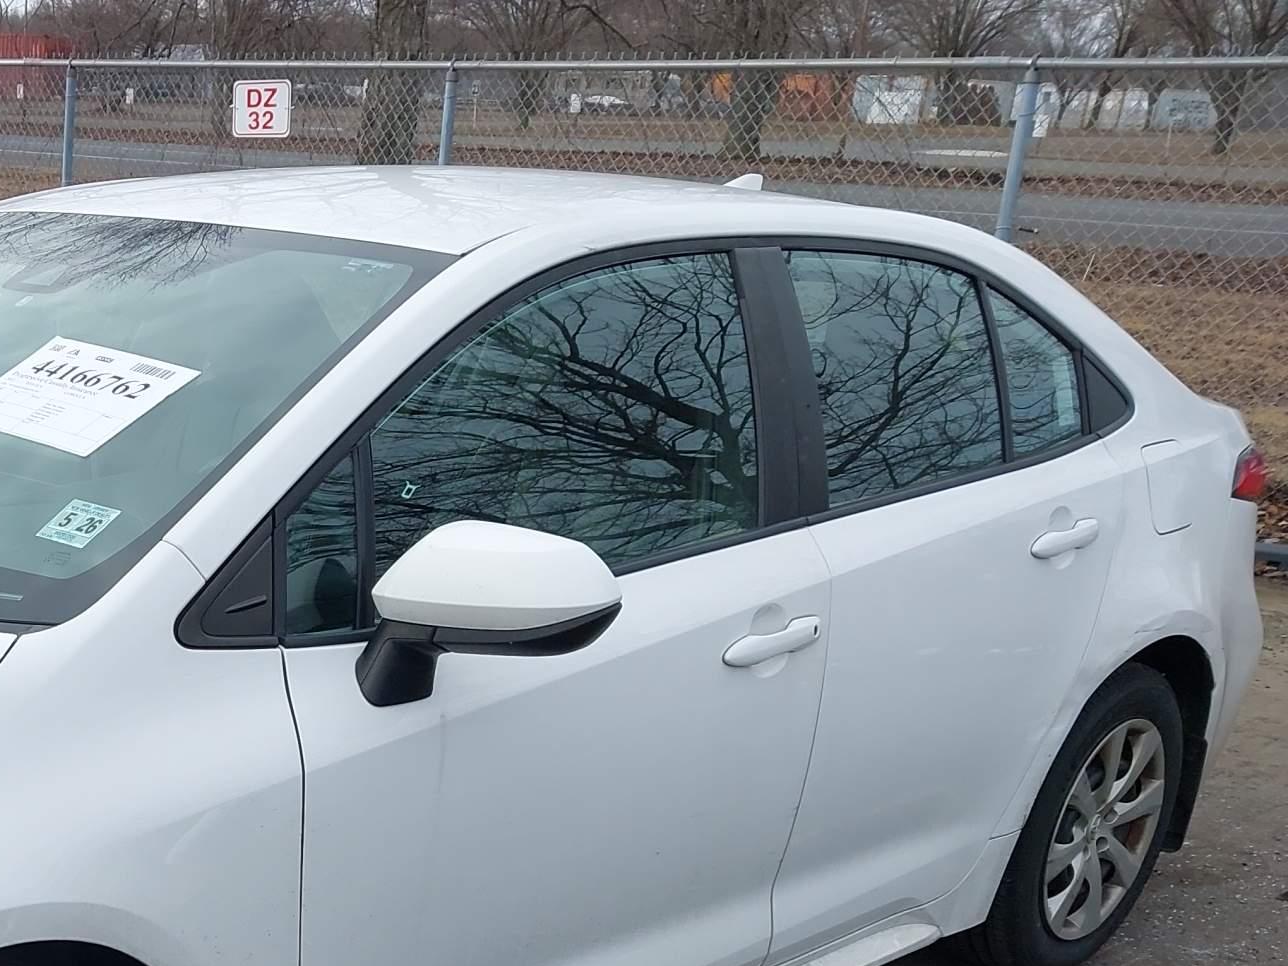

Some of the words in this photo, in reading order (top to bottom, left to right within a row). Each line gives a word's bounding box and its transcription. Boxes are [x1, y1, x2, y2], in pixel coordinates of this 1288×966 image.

[247, 88, 278, 108] DZ
[248, 110, 274, 130] 32
[31, 359, 151, 400] 44166762
[58, 512, 78, 527] 5
[74, 516, 103, 535] 26
